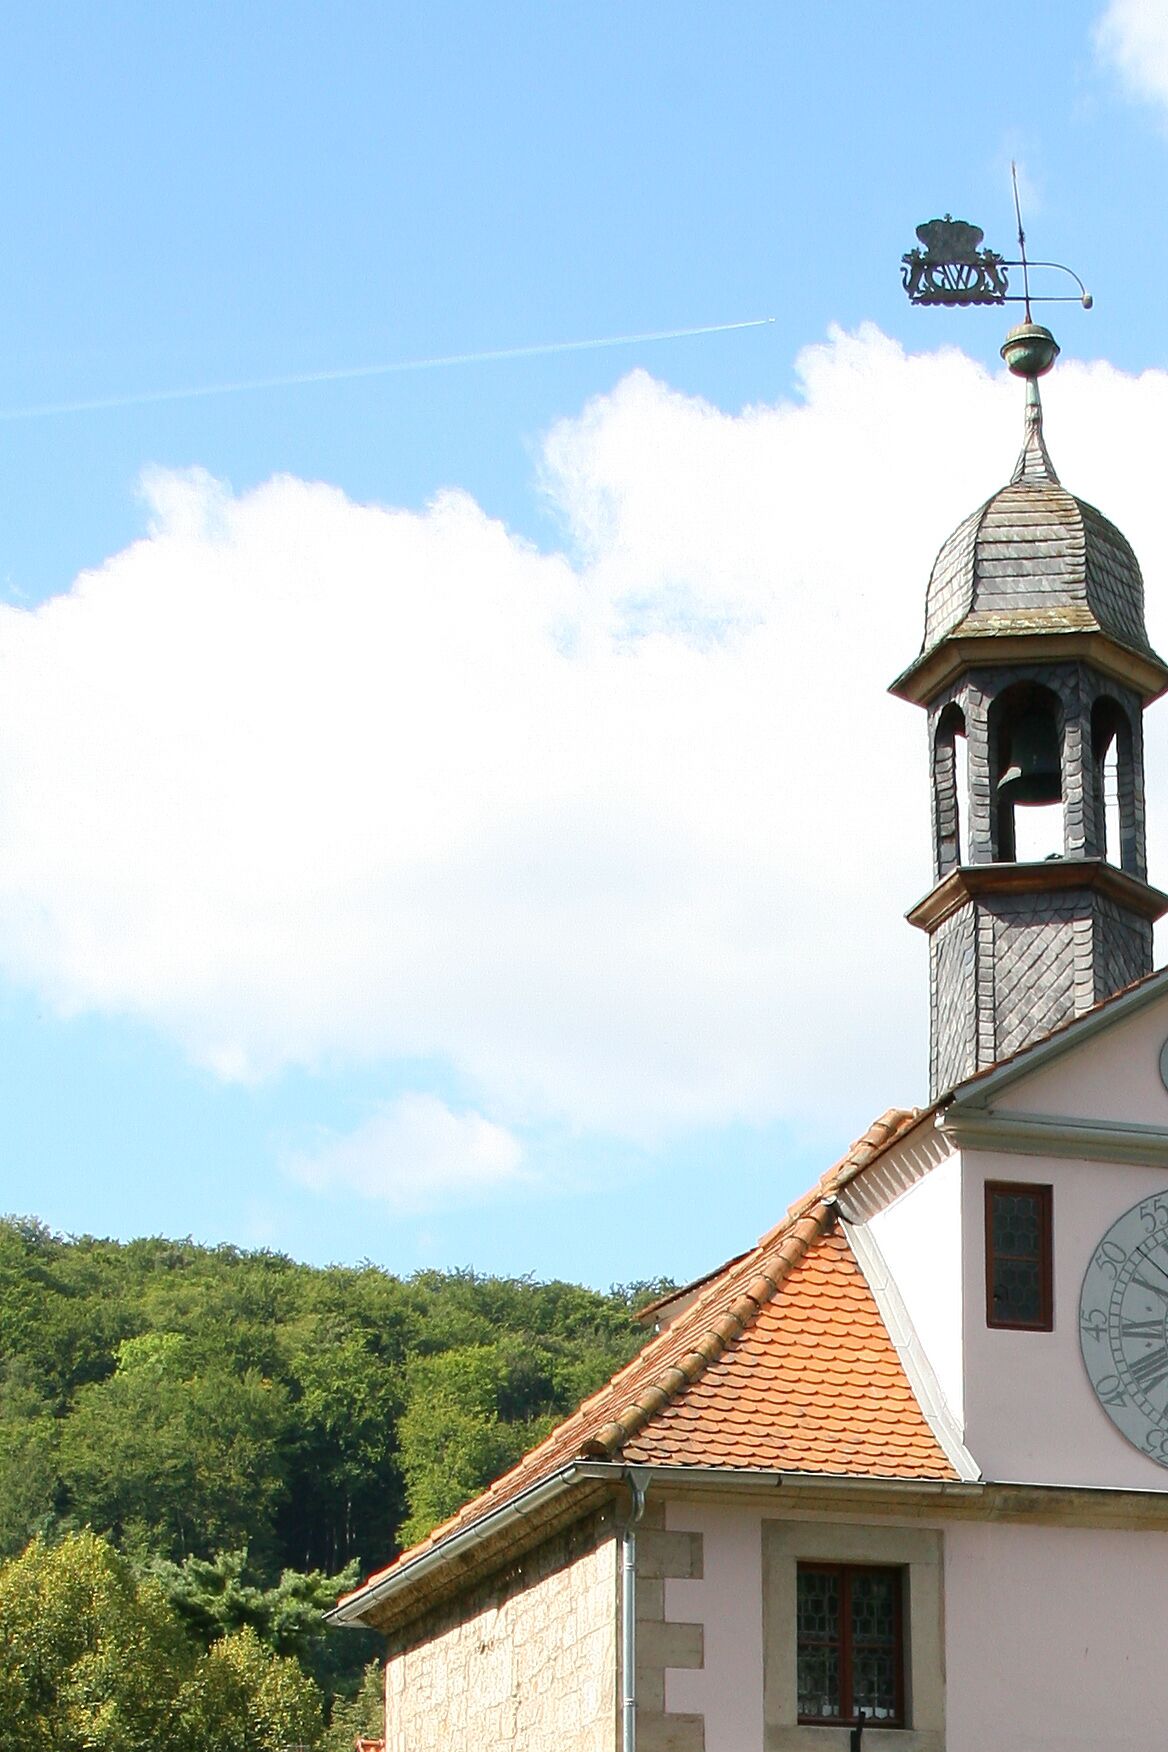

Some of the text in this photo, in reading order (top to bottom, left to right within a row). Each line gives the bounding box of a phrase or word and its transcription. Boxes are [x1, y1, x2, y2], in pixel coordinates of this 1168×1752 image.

[1094, 1240, 1128, 1281] 50
[1080, 1308, 1108, 1343] 45
[1096, 1374, 1128, 1408] 40
